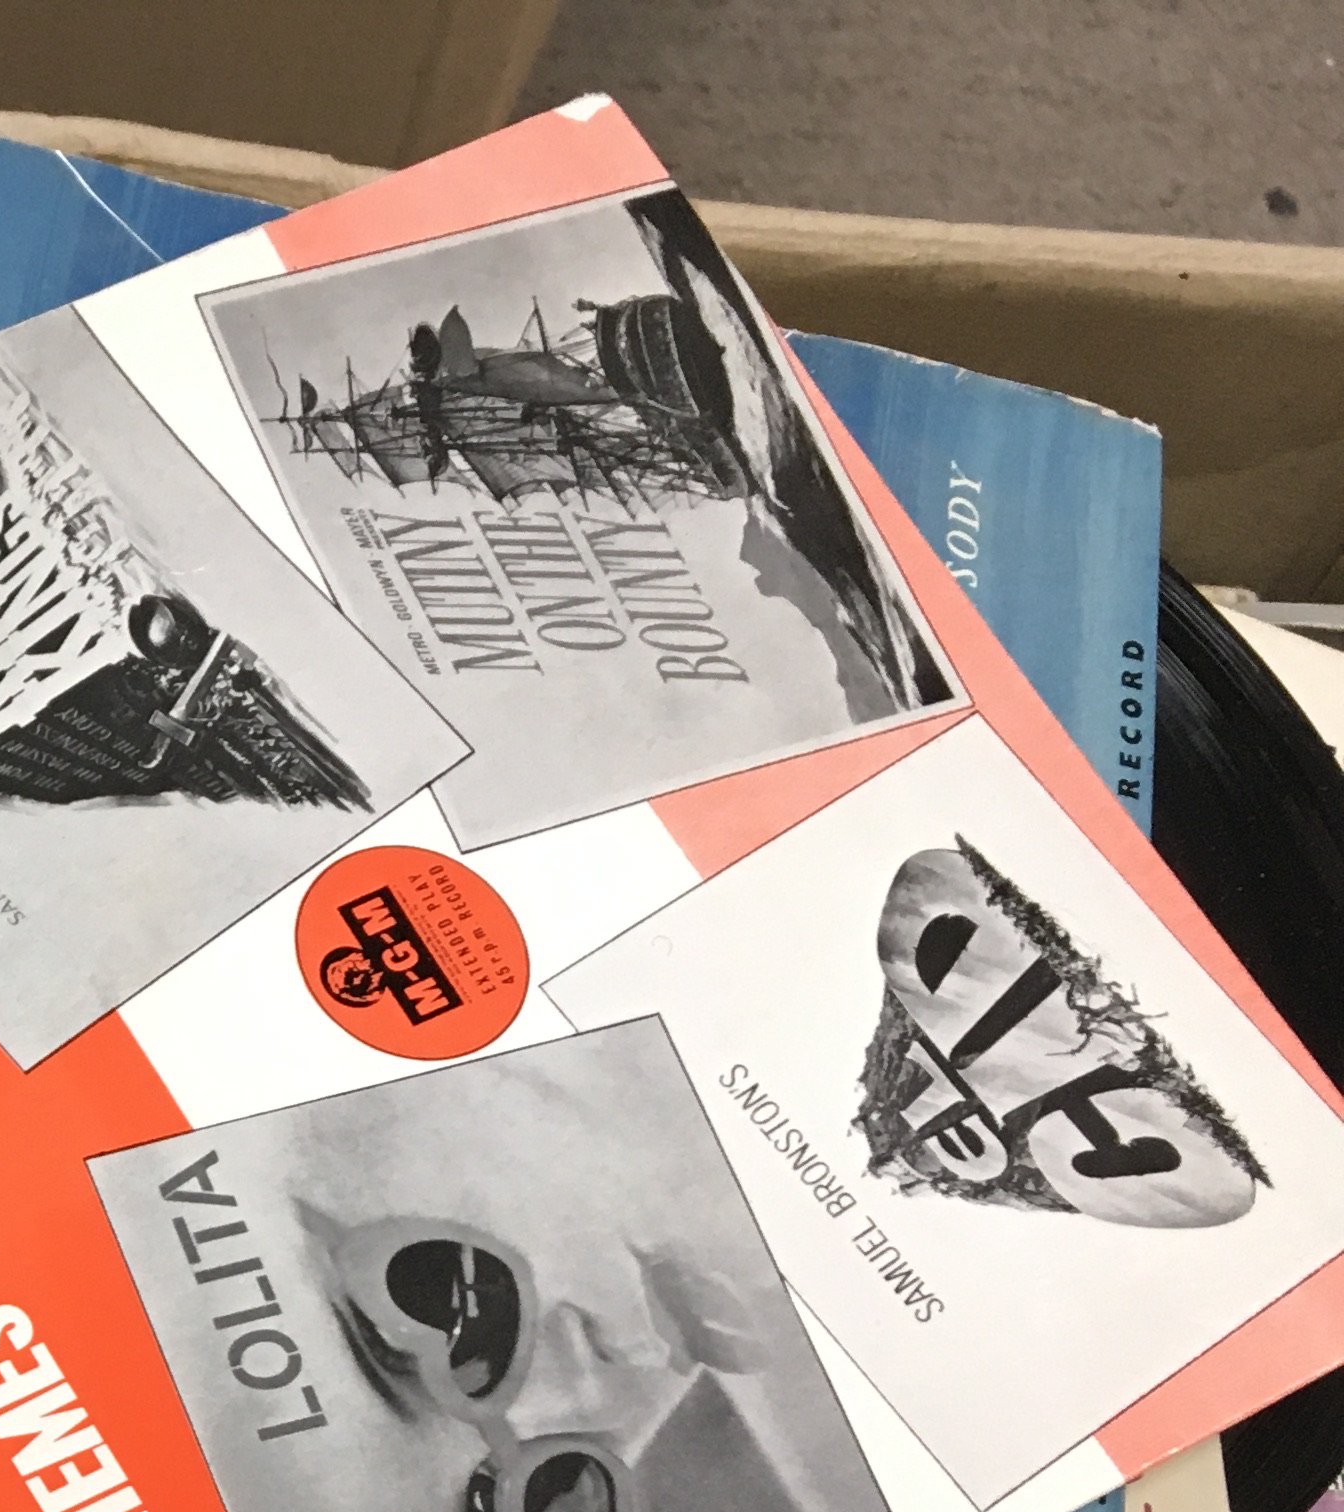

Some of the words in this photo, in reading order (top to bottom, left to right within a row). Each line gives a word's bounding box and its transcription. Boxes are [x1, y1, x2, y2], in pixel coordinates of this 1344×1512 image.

[338, 503, 373, 552] MAYER
[473, 511, 596, 586] THE
[366, 555, 412, 624] GOLDWYN
[369, 509, 544, 676] MUTINY
[517, 592, 626, 651] ON
[574, 512, 749, 683] BOUNTY
[406, 627, 442, 678] METRO
[1118, 638, 1146, 799] RECORD
[408, 873, 439, 912] PLAY
[429, 864, 473, 922] RECORD
[350, 896, 450, 1017] M-G-M
[438, 918, 497, 995] EXTENDED
[494, 966, 515, 985] 45
[877, 848, 1258, 1230] CID
[718, 1063, 858, 1219] BRONSTON'S
[902, 1039, 1014, 1182] EL
[159, 1150, 328, 1440] LOLITA
[852, 1215, 945, 1324] SAMUEL
